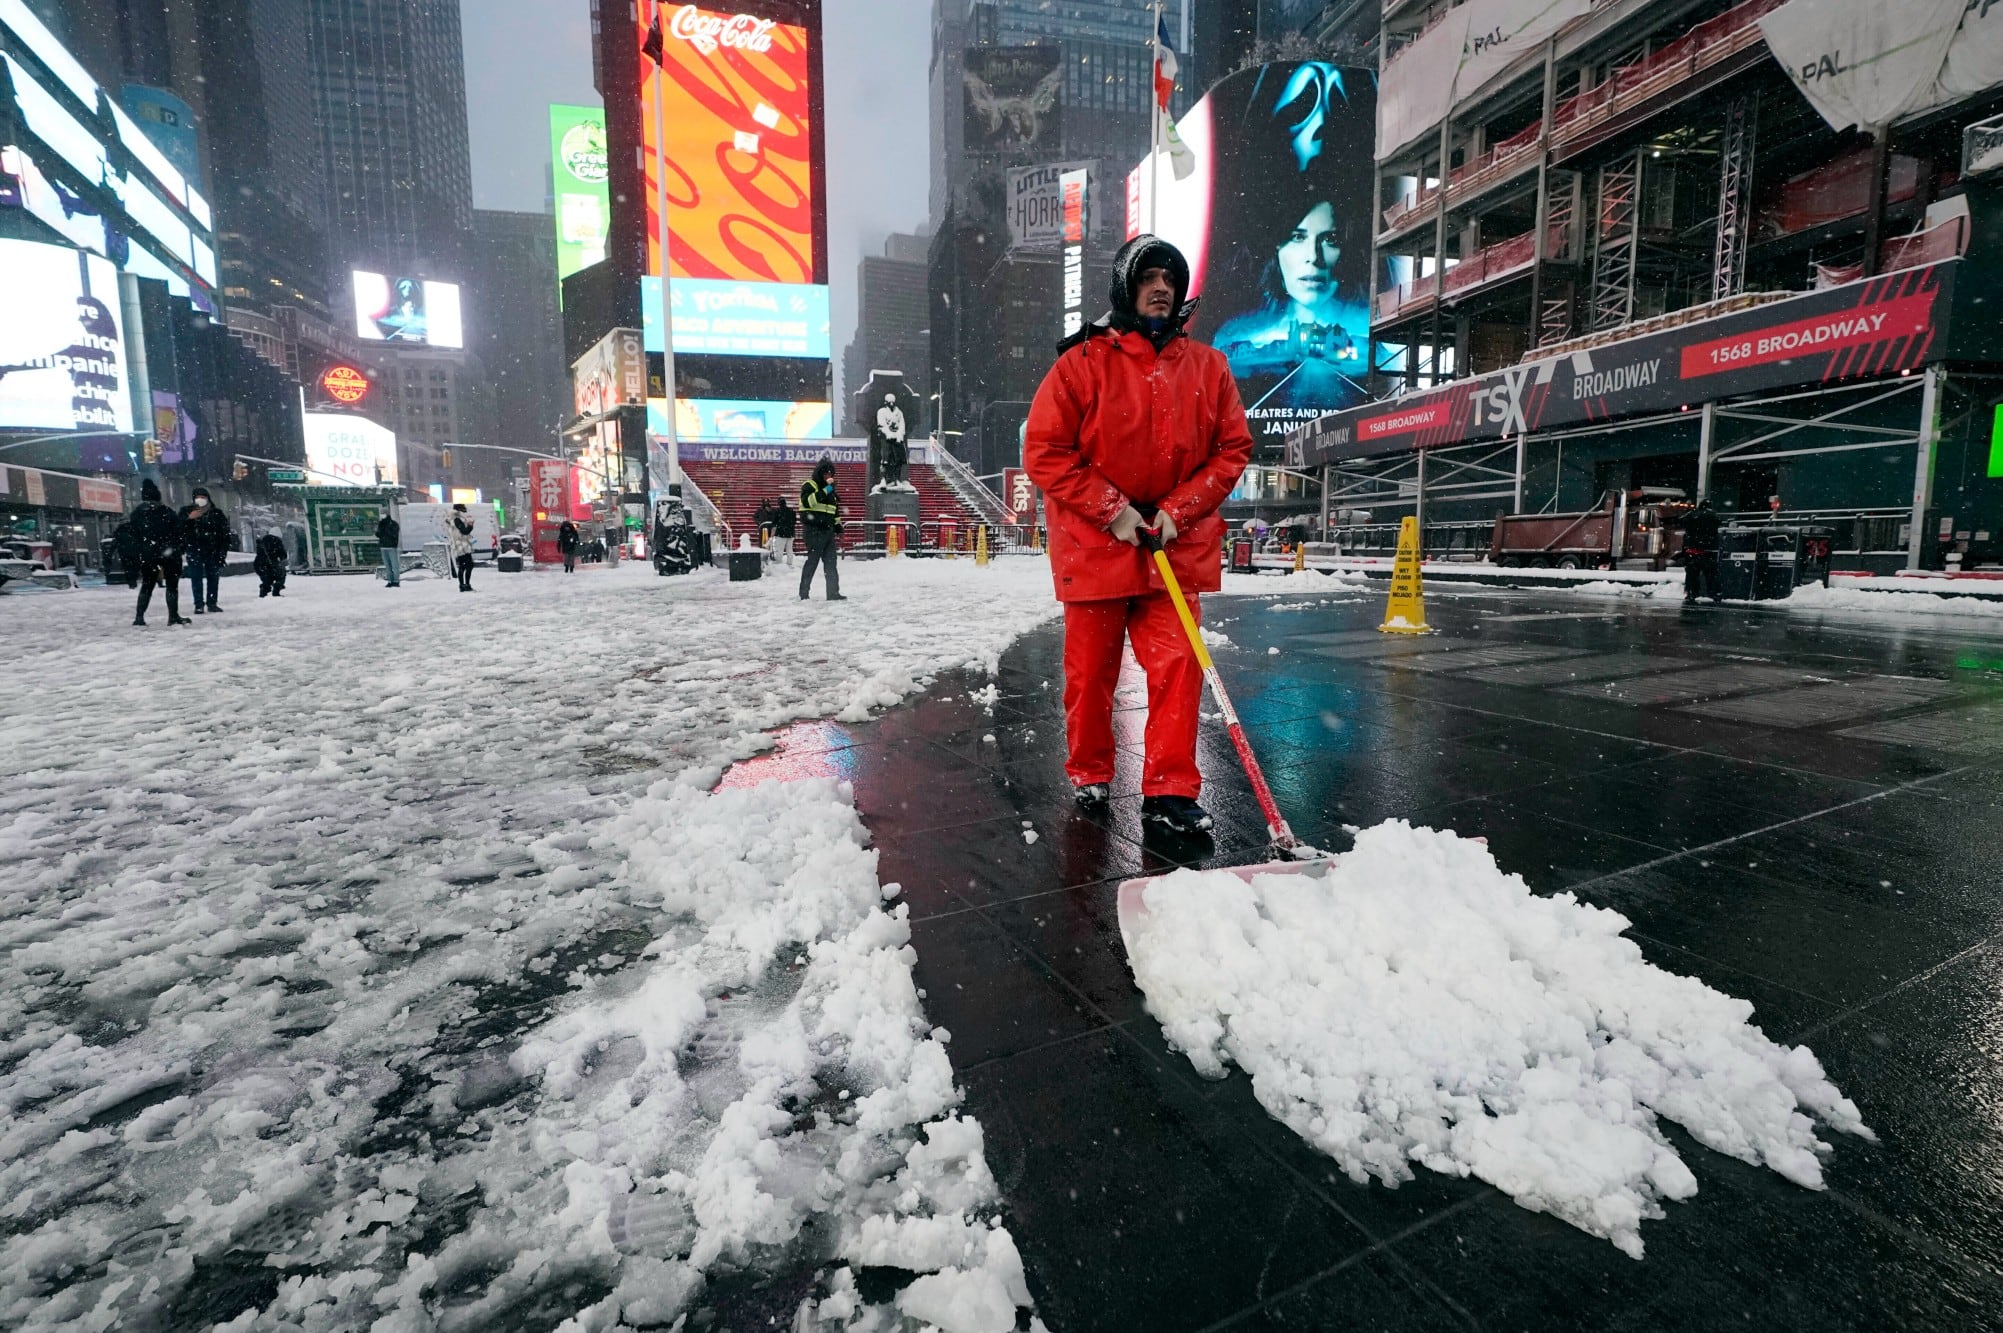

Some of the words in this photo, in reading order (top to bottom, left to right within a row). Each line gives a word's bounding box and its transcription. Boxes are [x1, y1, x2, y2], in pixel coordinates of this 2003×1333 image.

[670, 5, 776, 52] Coca-Cola
[1016, 168, 1059, 194] LITTLE
[1064, 246, 1082, 309] PATRICIA
[1711, 342, 1751, 364] 1568
[1757, 313, 1886, 355] BROADWAY
[624, 335, 641, 403] HELLO!
[1296, 409, 1318, 418] AND
[1469, 370, 1528, 432] TSX
[1573, 358, 1661, 400] BROADWAY
[1315, 427, 1350, 450] BROADWAY
[1369, 420, 1386, 433] 1568
[1387, 410, 1435, 431] BROADWAY
[703, 447, 781, 460] WELCOME
[1013, 473, 1032, 512] tkts
